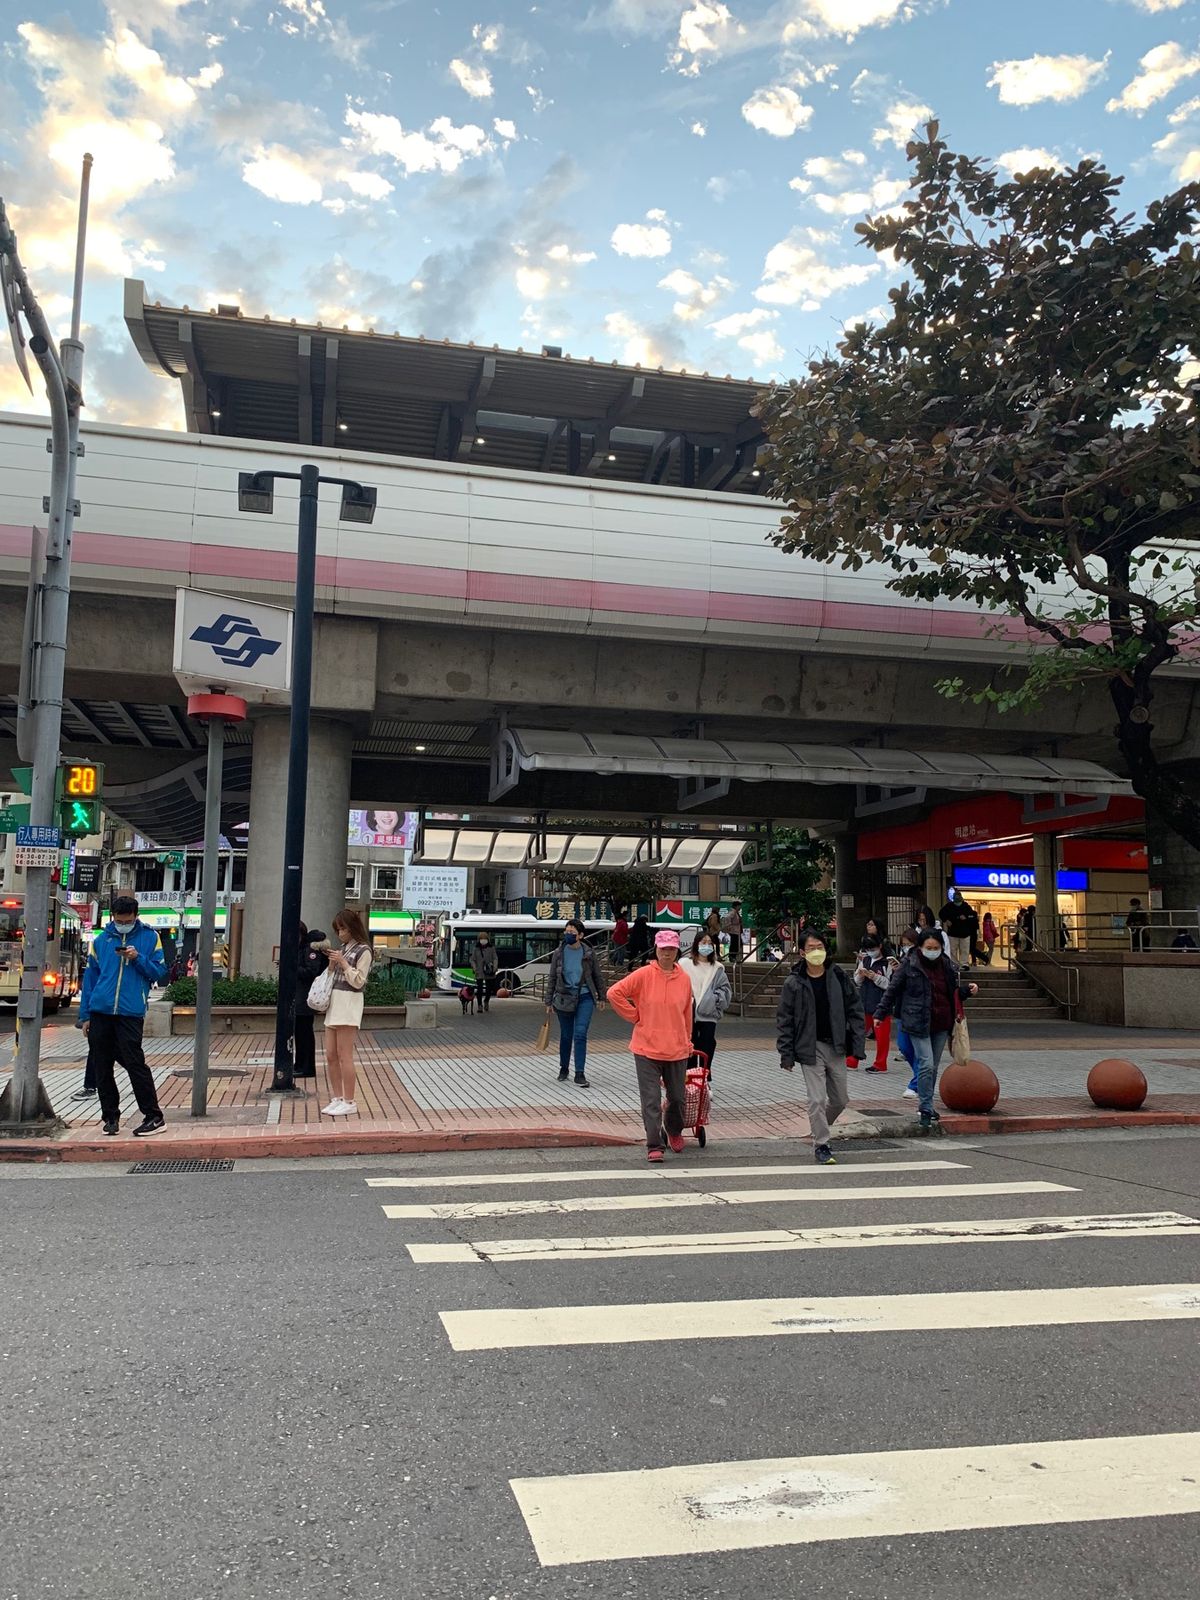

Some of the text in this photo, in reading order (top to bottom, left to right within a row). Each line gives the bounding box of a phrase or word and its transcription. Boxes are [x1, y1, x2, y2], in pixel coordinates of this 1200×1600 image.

[69, 767, 94, 793] 20
[18, 827, 58, 842] 行人專用時相
